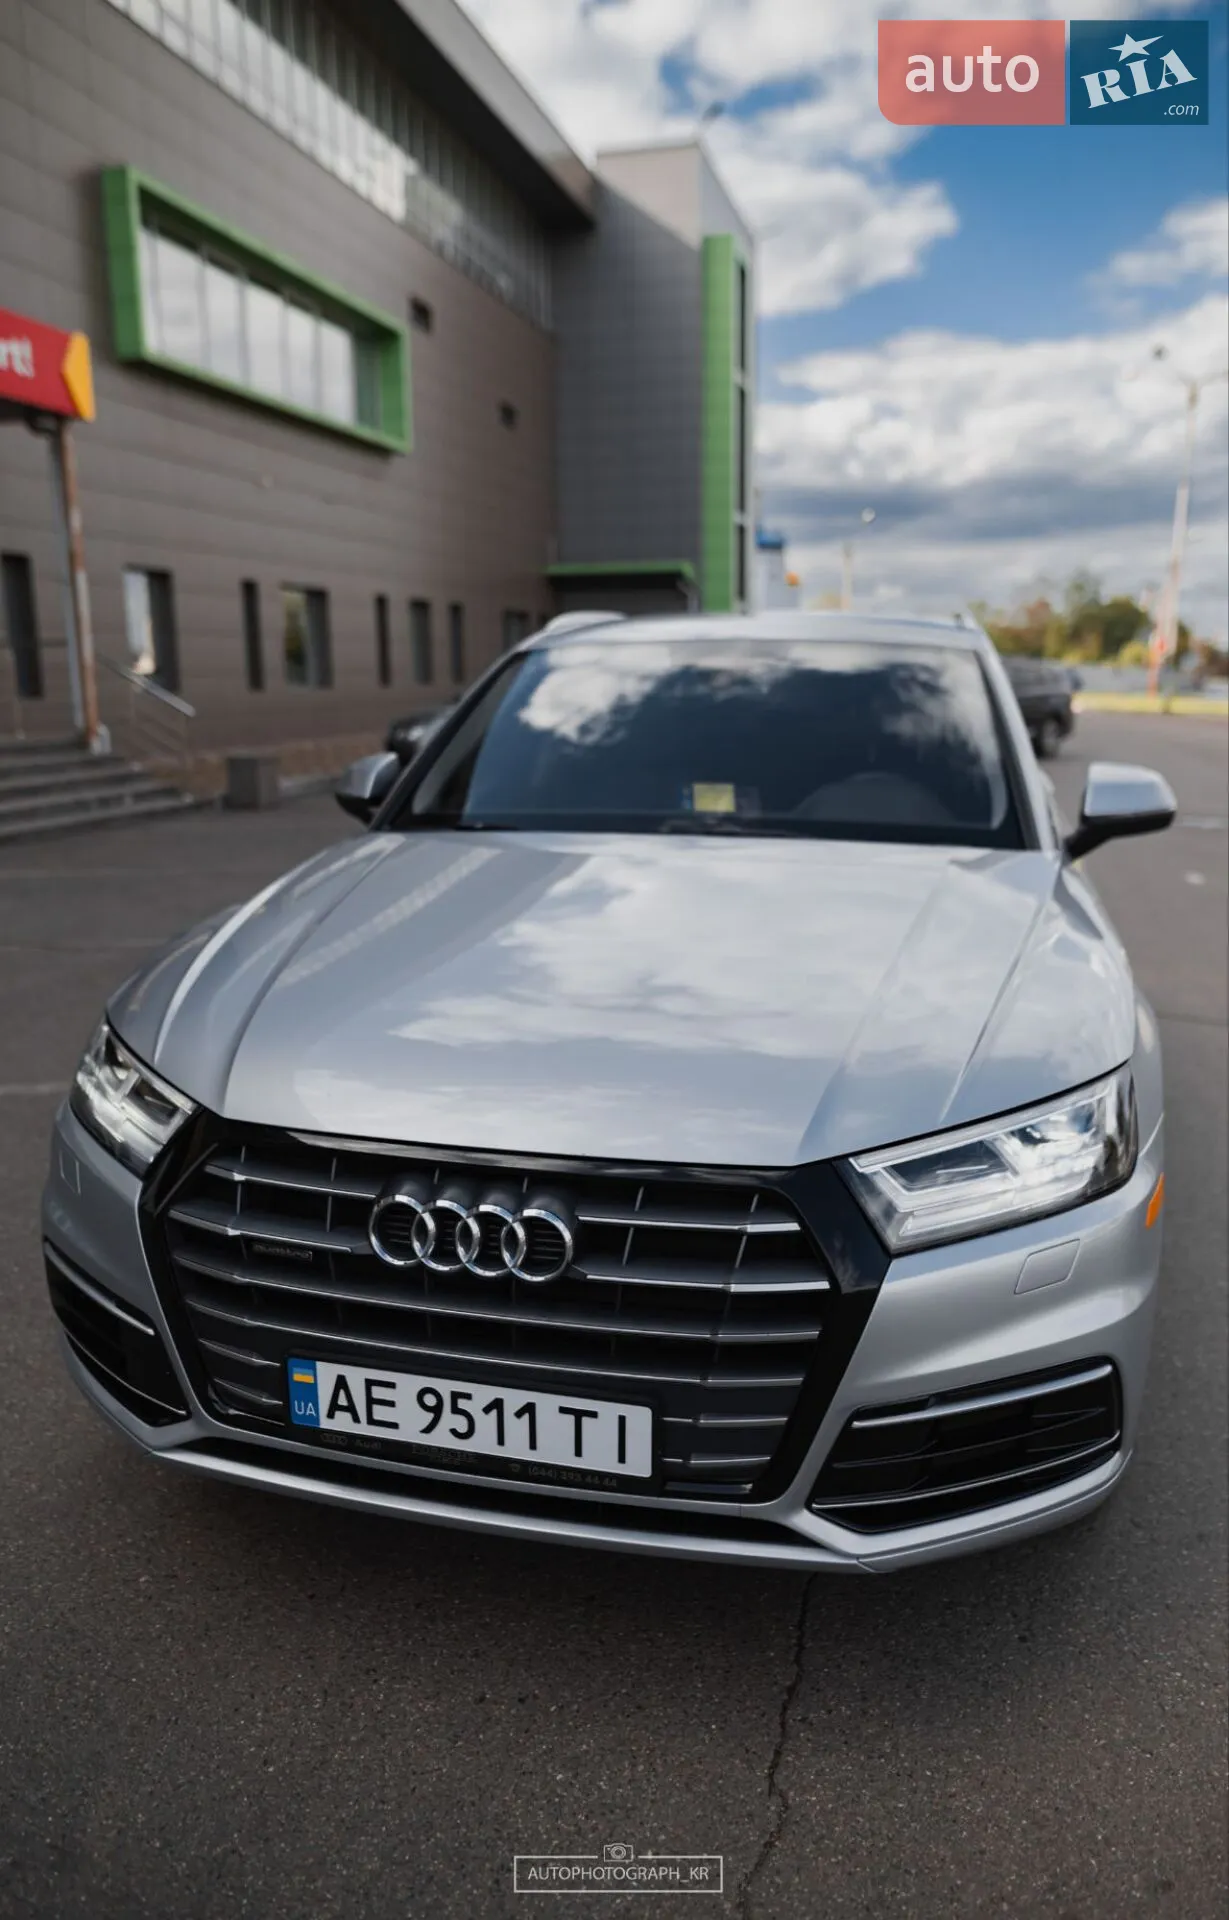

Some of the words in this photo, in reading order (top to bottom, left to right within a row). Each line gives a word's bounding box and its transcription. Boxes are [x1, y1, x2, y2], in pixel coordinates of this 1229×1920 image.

[294, 1400, 317, 1417] UA
[326, 1374, 399, 1429] AE
[416, 1386, 537, 1450] 9511
[558, 1405, 626, 1464] TI
